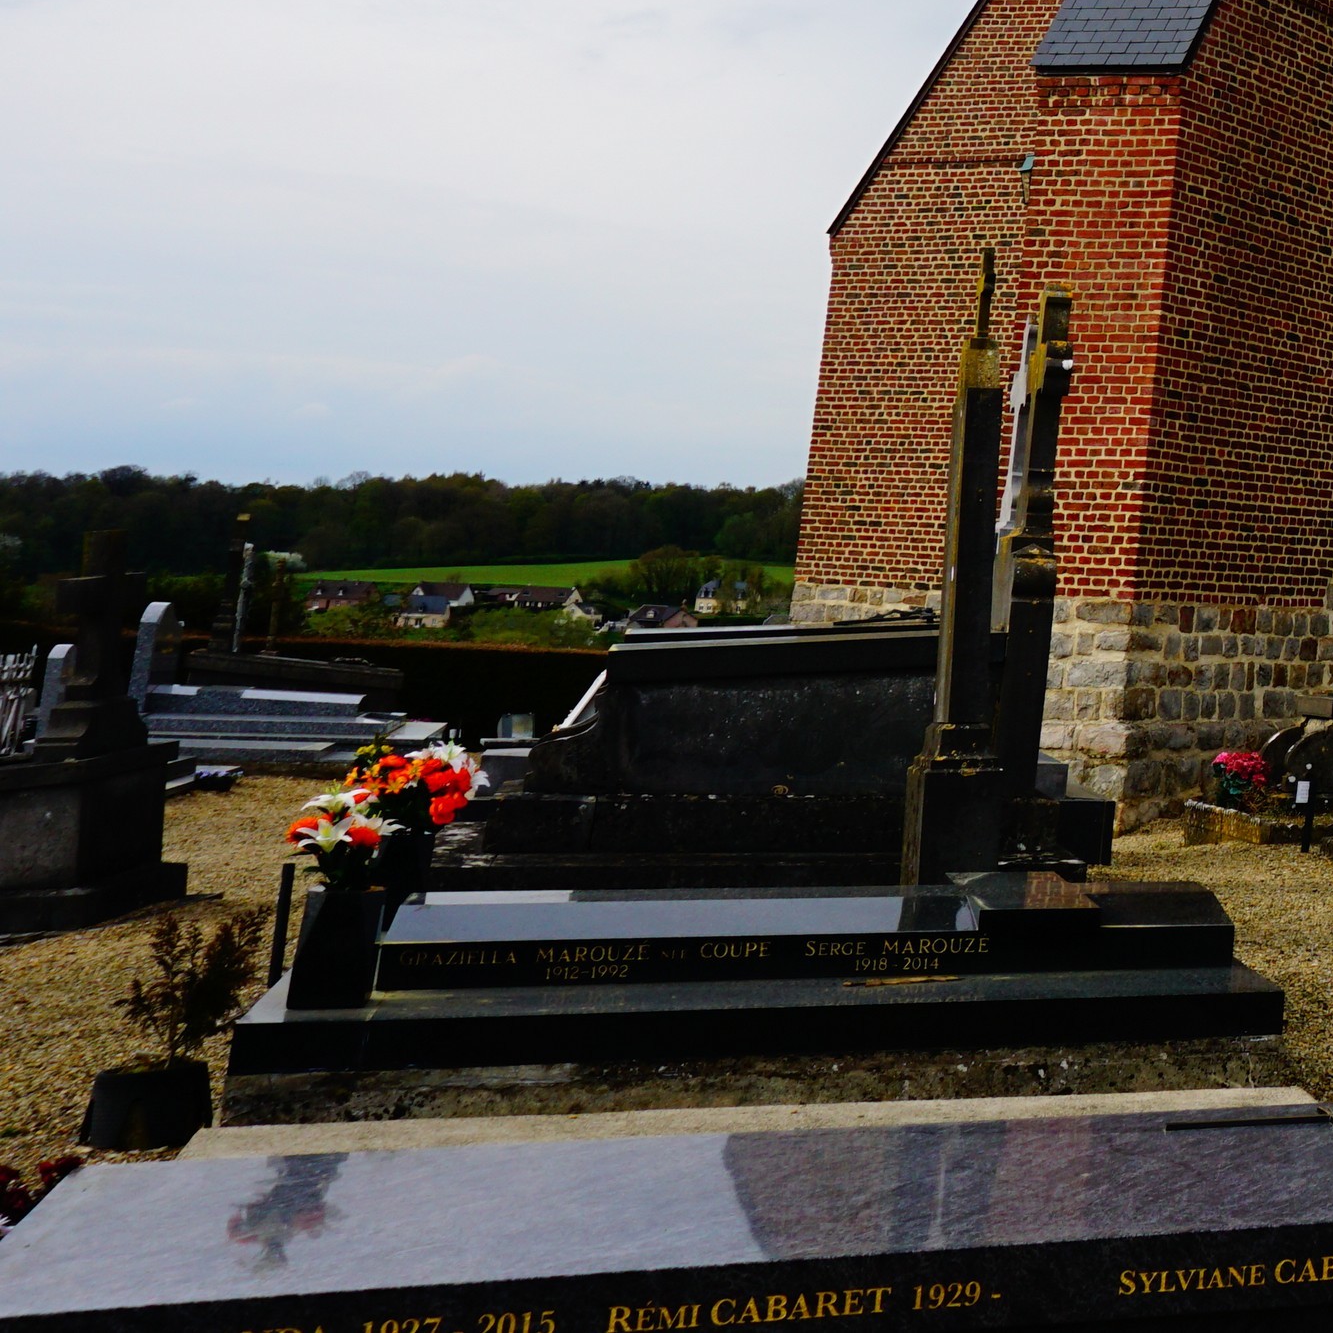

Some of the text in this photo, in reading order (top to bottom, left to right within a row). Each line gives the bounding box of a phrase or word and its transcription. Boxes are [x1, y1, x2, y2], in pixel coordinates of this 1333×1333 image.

[535, 940, 650, 964] MAROUZÉ
[700, 941, 772, 960] COUPE
[805, 933, 989, 957] SERGE MAROUZÉ
[855, 958, 888, 971] 1918
[903, 957, 940, 971] 2014
[1118, 1265, 1266, 1295] SYLVIANE
[606, 1300, 701, 1333] RÉMI
[711, 1286, 893, 1326] CABARET
[912, 1280, 982, 1310] 1929
[477, 1310, 556, 1333] 2015
